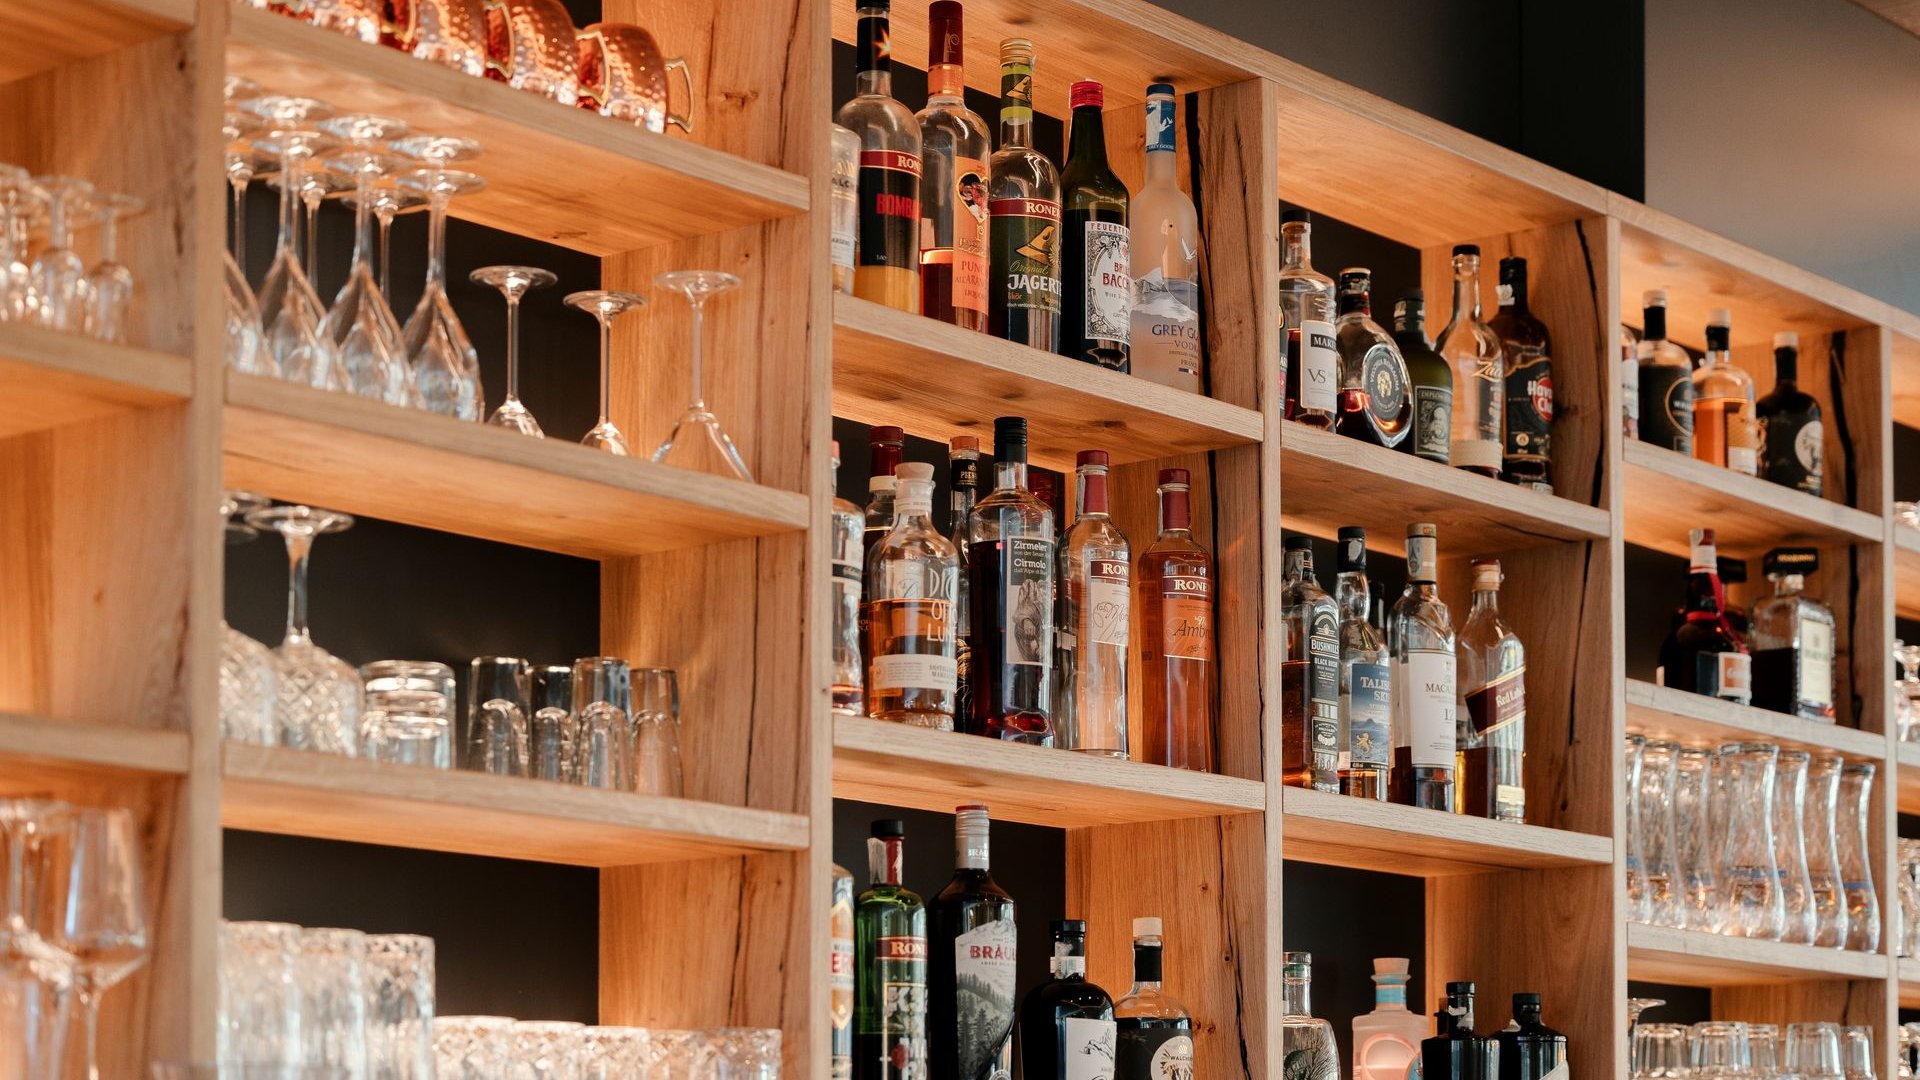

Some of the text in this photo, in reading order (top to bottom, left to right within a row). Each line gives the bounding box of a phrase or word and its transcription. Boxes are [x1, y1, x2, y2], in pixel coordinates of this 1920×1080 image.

[1152, 324, 1184, 336] GREY
[1308, 368, 1326, 383] VS
[1014, 558, 1046, 569] Cirmolo
[1496, 690, 1510, 707] Red
[1445, 708, 1454, 720] 12
